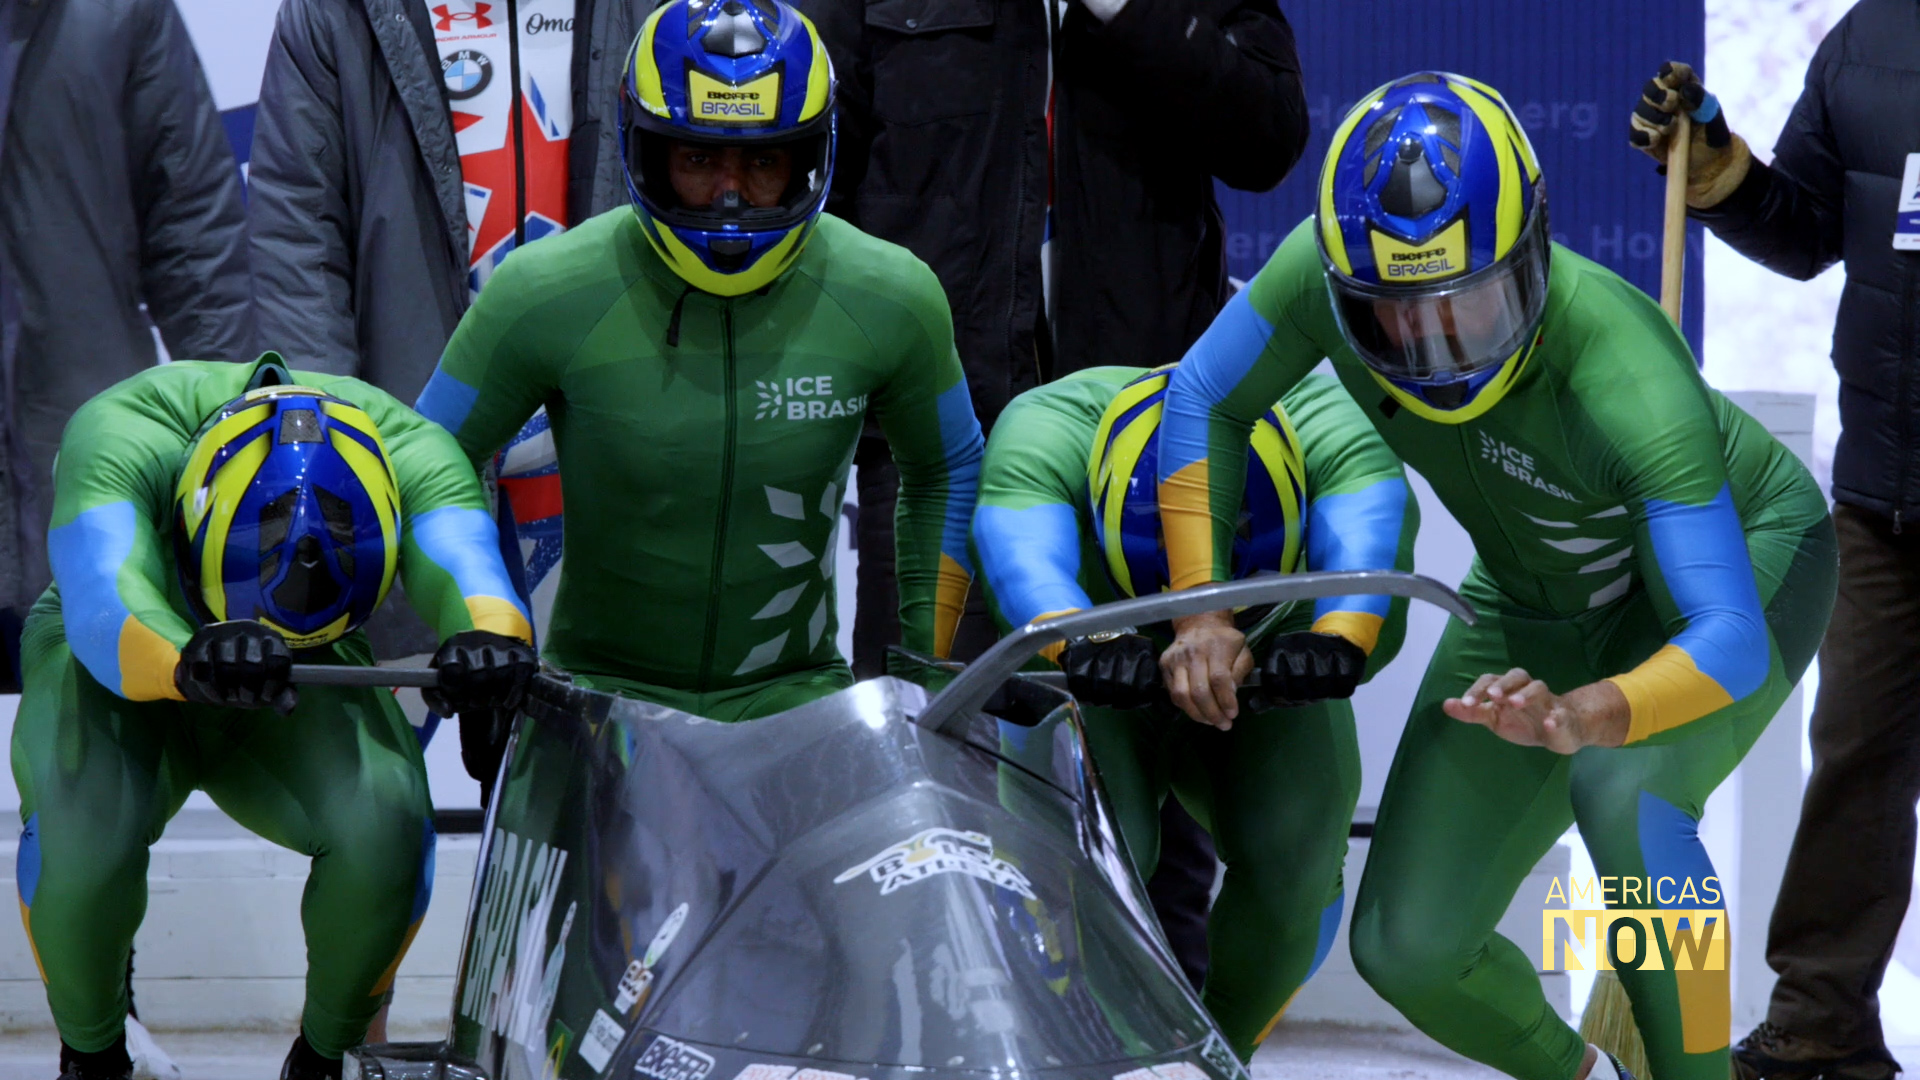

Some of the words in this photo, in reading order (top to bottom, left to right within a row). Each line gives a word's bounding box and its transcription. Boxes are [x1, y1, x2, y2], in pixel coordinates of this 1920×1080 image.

[441, 50, 489, 71] BMW
[701, 102, 765, 116] BRASIL
[1387, 258, 1455, 277] BRASIL
[786, 376, 833, 397] ICE
[1500, 441, 1535, 472] ICE
[1502, 459, 1583, 503] BRASIL
